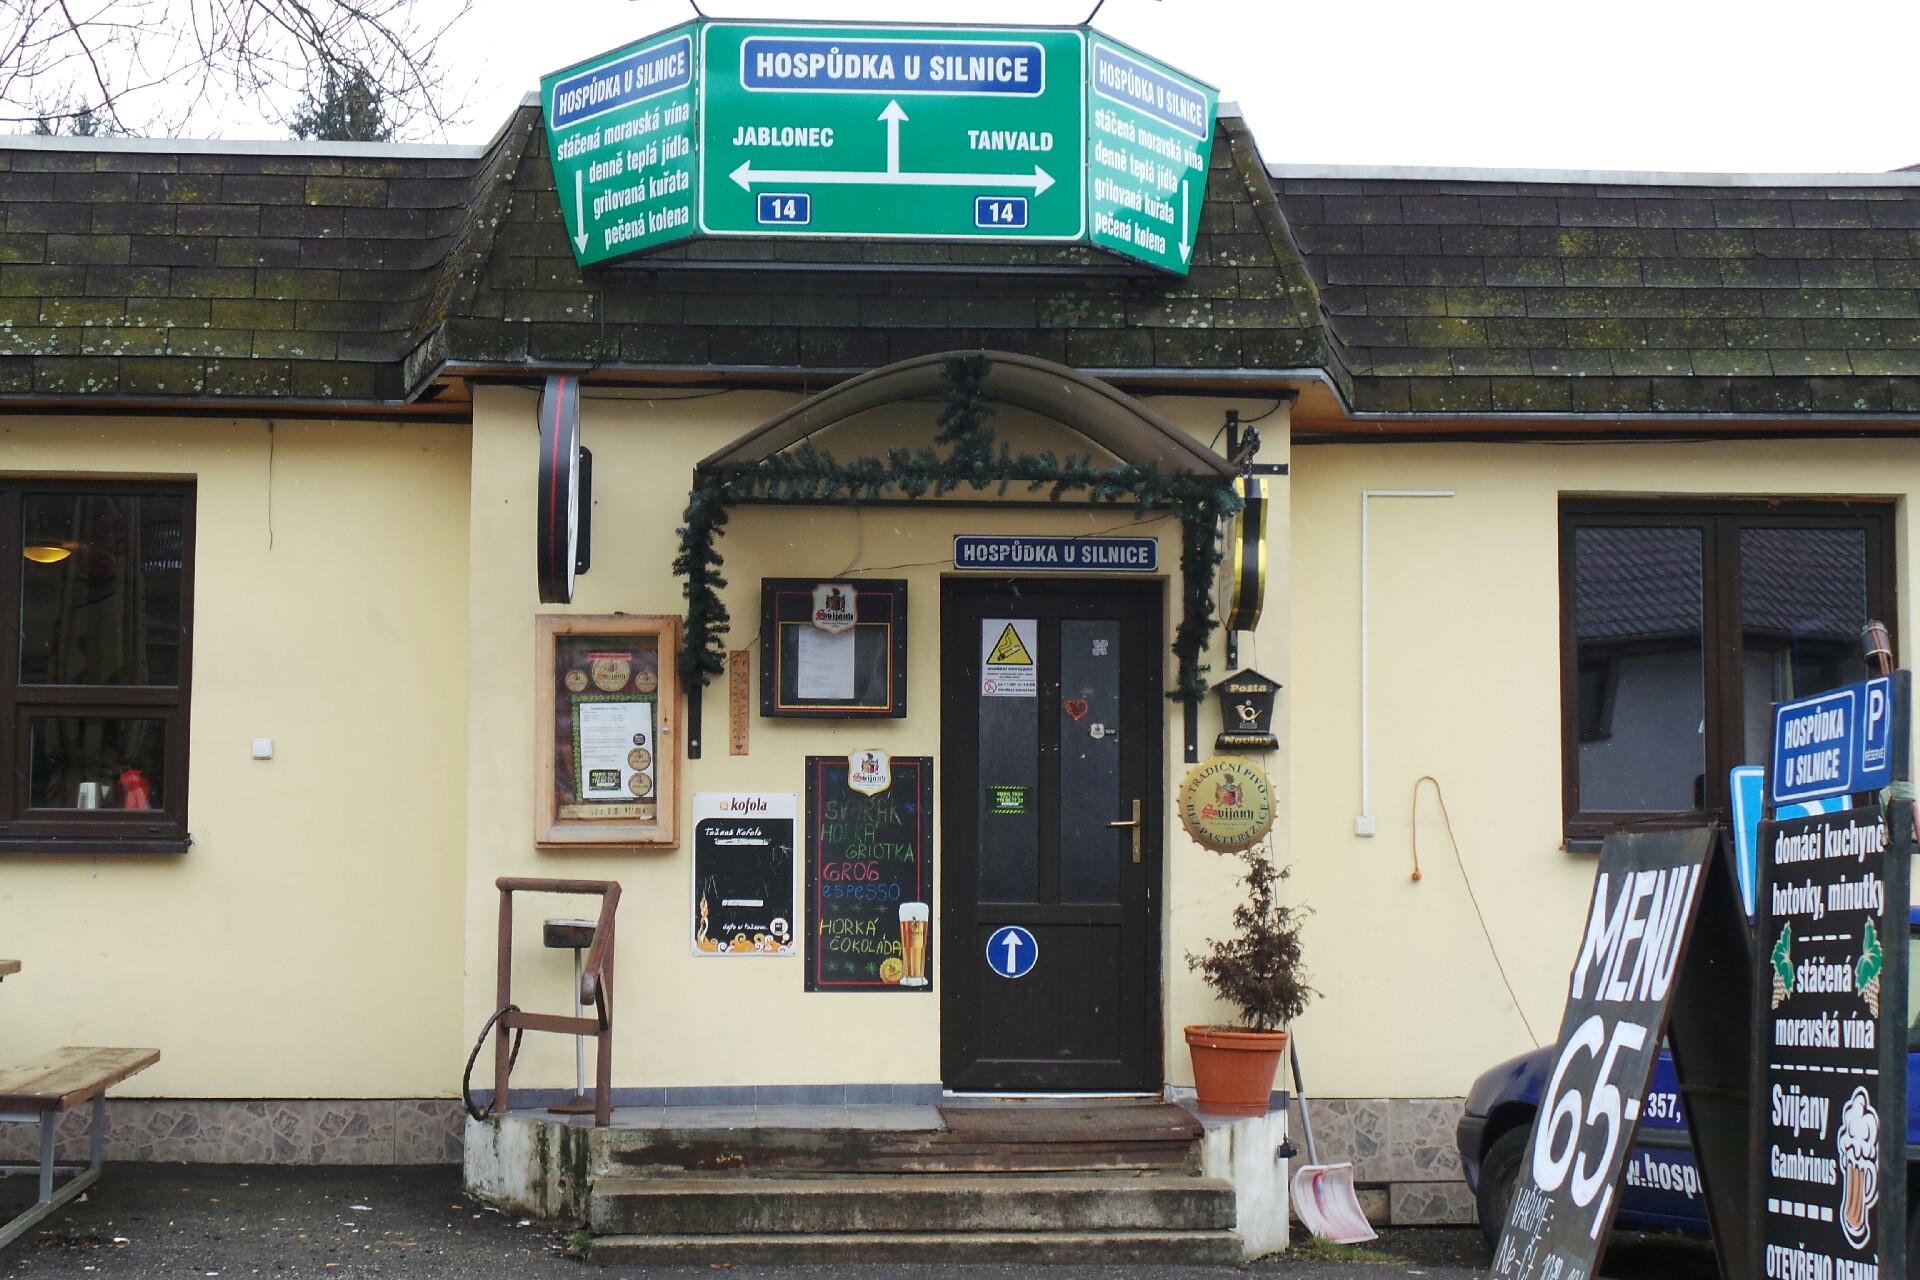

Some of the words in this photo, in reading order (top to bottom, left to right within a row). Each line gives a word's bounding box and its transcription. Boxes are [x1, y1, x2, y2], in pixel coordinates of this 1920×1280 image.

[559, 76, 621, 116] HOSPŮDKA
[624, 69, 633, 93] U
[636, 51, 685, 89] SILNICE
[756, 46, 896, 80] HOSPŮDKA
[904, 55, 920, 81] U
[929, 55, 1029, 82] SILNICE
[1100, 59, 1154, 104] HOSPŮDKA
[1157, 85, 1164, 109] U
[1166, 88, 1203, 127] SILNICE
[557, 125, 601, 161] stáčená
[604, 106, 660, 146] moravská
[664, 100, 690, 126] vína
[732, 126, 834, 147] JABLONEC
[967, 130, 1053, 151] TANVALD
[1095, 108, 1135, 139] stáčená
[1138, 126, 1181, 162] moravská
[1184, 140, 1204, 172] vína
[588, 151, 623, 184] denně
[627, 141, 657, 173] teplá
[661, 134, 690, 167] jídla
[1095, 140, 1127, 172] denně
[1130, 153, 1155, 184] teplá
[1157, 161, 1178, 193] jídla
[593, 178, 645, 220] grilovaná
[649, 170, 690, 199] kuřata
[771, 199, 797, 220] 14
[988, 202, 1014, 223] 14
[1095, 177, 1142, 212] grilovaná
[1144, 195, 1175, 225] kuřata
[604, 212, 645, 250] pečená
[649, 205, 690, 233] kolena
[1095, 210, 1132, 243] pečená
[1134, 222, 1166, 254] kolena
[963, 540, 1059, 562] HOSPŮDKA
[1064, 545, 1076, 562] U
[1081, 546, 1149, 564] SILNICE
[1784, 706, 1844, 750] HOSPŮDKA
[1867, 688, 1884, 741] P
[1188, 761, 1242, 793] TRADIČNÍ
[1243, 768, 1266, 794] PIVO
[1785, 757, 1795, 788] U
[1795, 747, 1841, 786] SILNICE
[731, 797, 767, 815] kofola
[1201, 803, 1254, 820] Svijany
[845, 843, 915, 863] GRIOTKA
[1775, 823, 1822, 865] domácí
[823, 861, 880, 881] GROG
[1772, 879, 1825, 920] hotovky,
[1827, 872, 1884, 918] minutky
[819, 917, 879, 937] HORKÁ
[829, 934, 903, 957] ČOKOLÁDA
[1572, 863, 1701, 1001] MENU
[1796, 954, 1852, 994] stáčená
[1775, 1010, 1840, 1048] moravská
[1843, 1010, 1875, 1049] vína
[1771, 1083, 1829, 1141] Svijany
[1771, 1144, 1837, 1186] Gambrinus
[1766, 1242, 1833, 1280] OTEVŘENO
[1836, 1253, 1879, 1280] DENN
